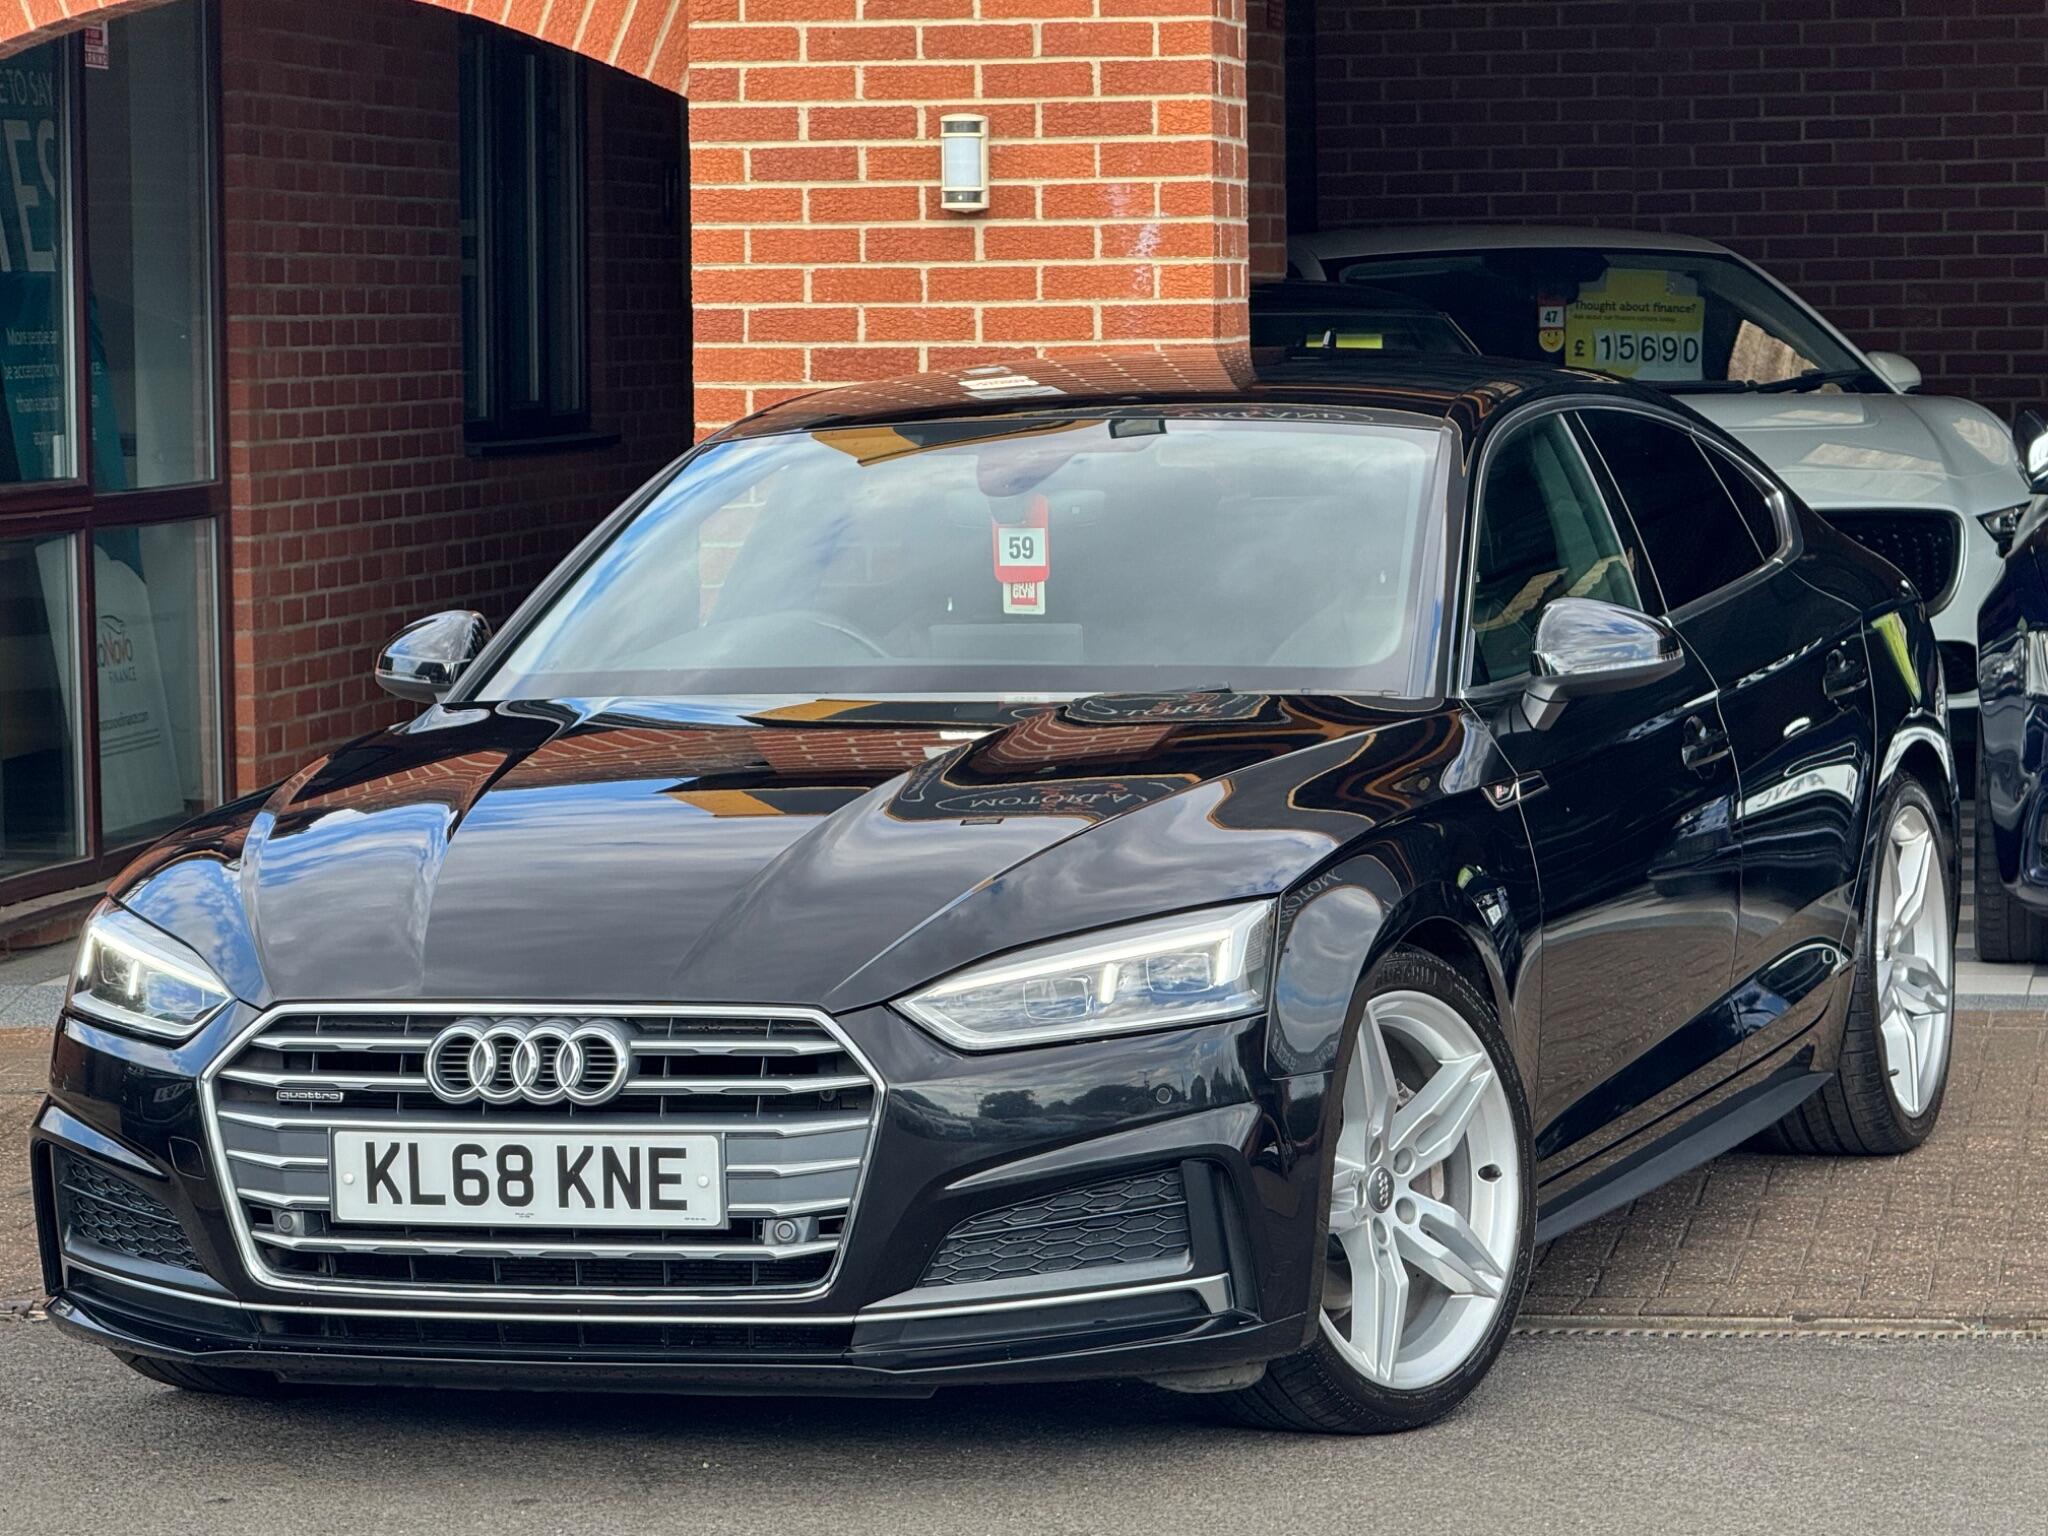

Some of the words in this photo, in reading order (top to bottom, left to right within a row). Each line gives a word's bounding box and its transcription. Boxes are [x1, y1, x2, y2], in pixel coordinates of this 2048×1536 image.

[1575, 300, 1616, 313] Thought
[1619, 301, 1649, 312] about
[1653, 302, 1696, 313] finance?
[1544, 310, 1558, 323] 47
[1600, 334, 1699, 363] 15690
[1008, 536, 1034, 560] 59
[279, 1091, 340, 1101] quattro
[365, 1142, 534, 1206] KL68
[556, 1145, 687, 1210] KNE
